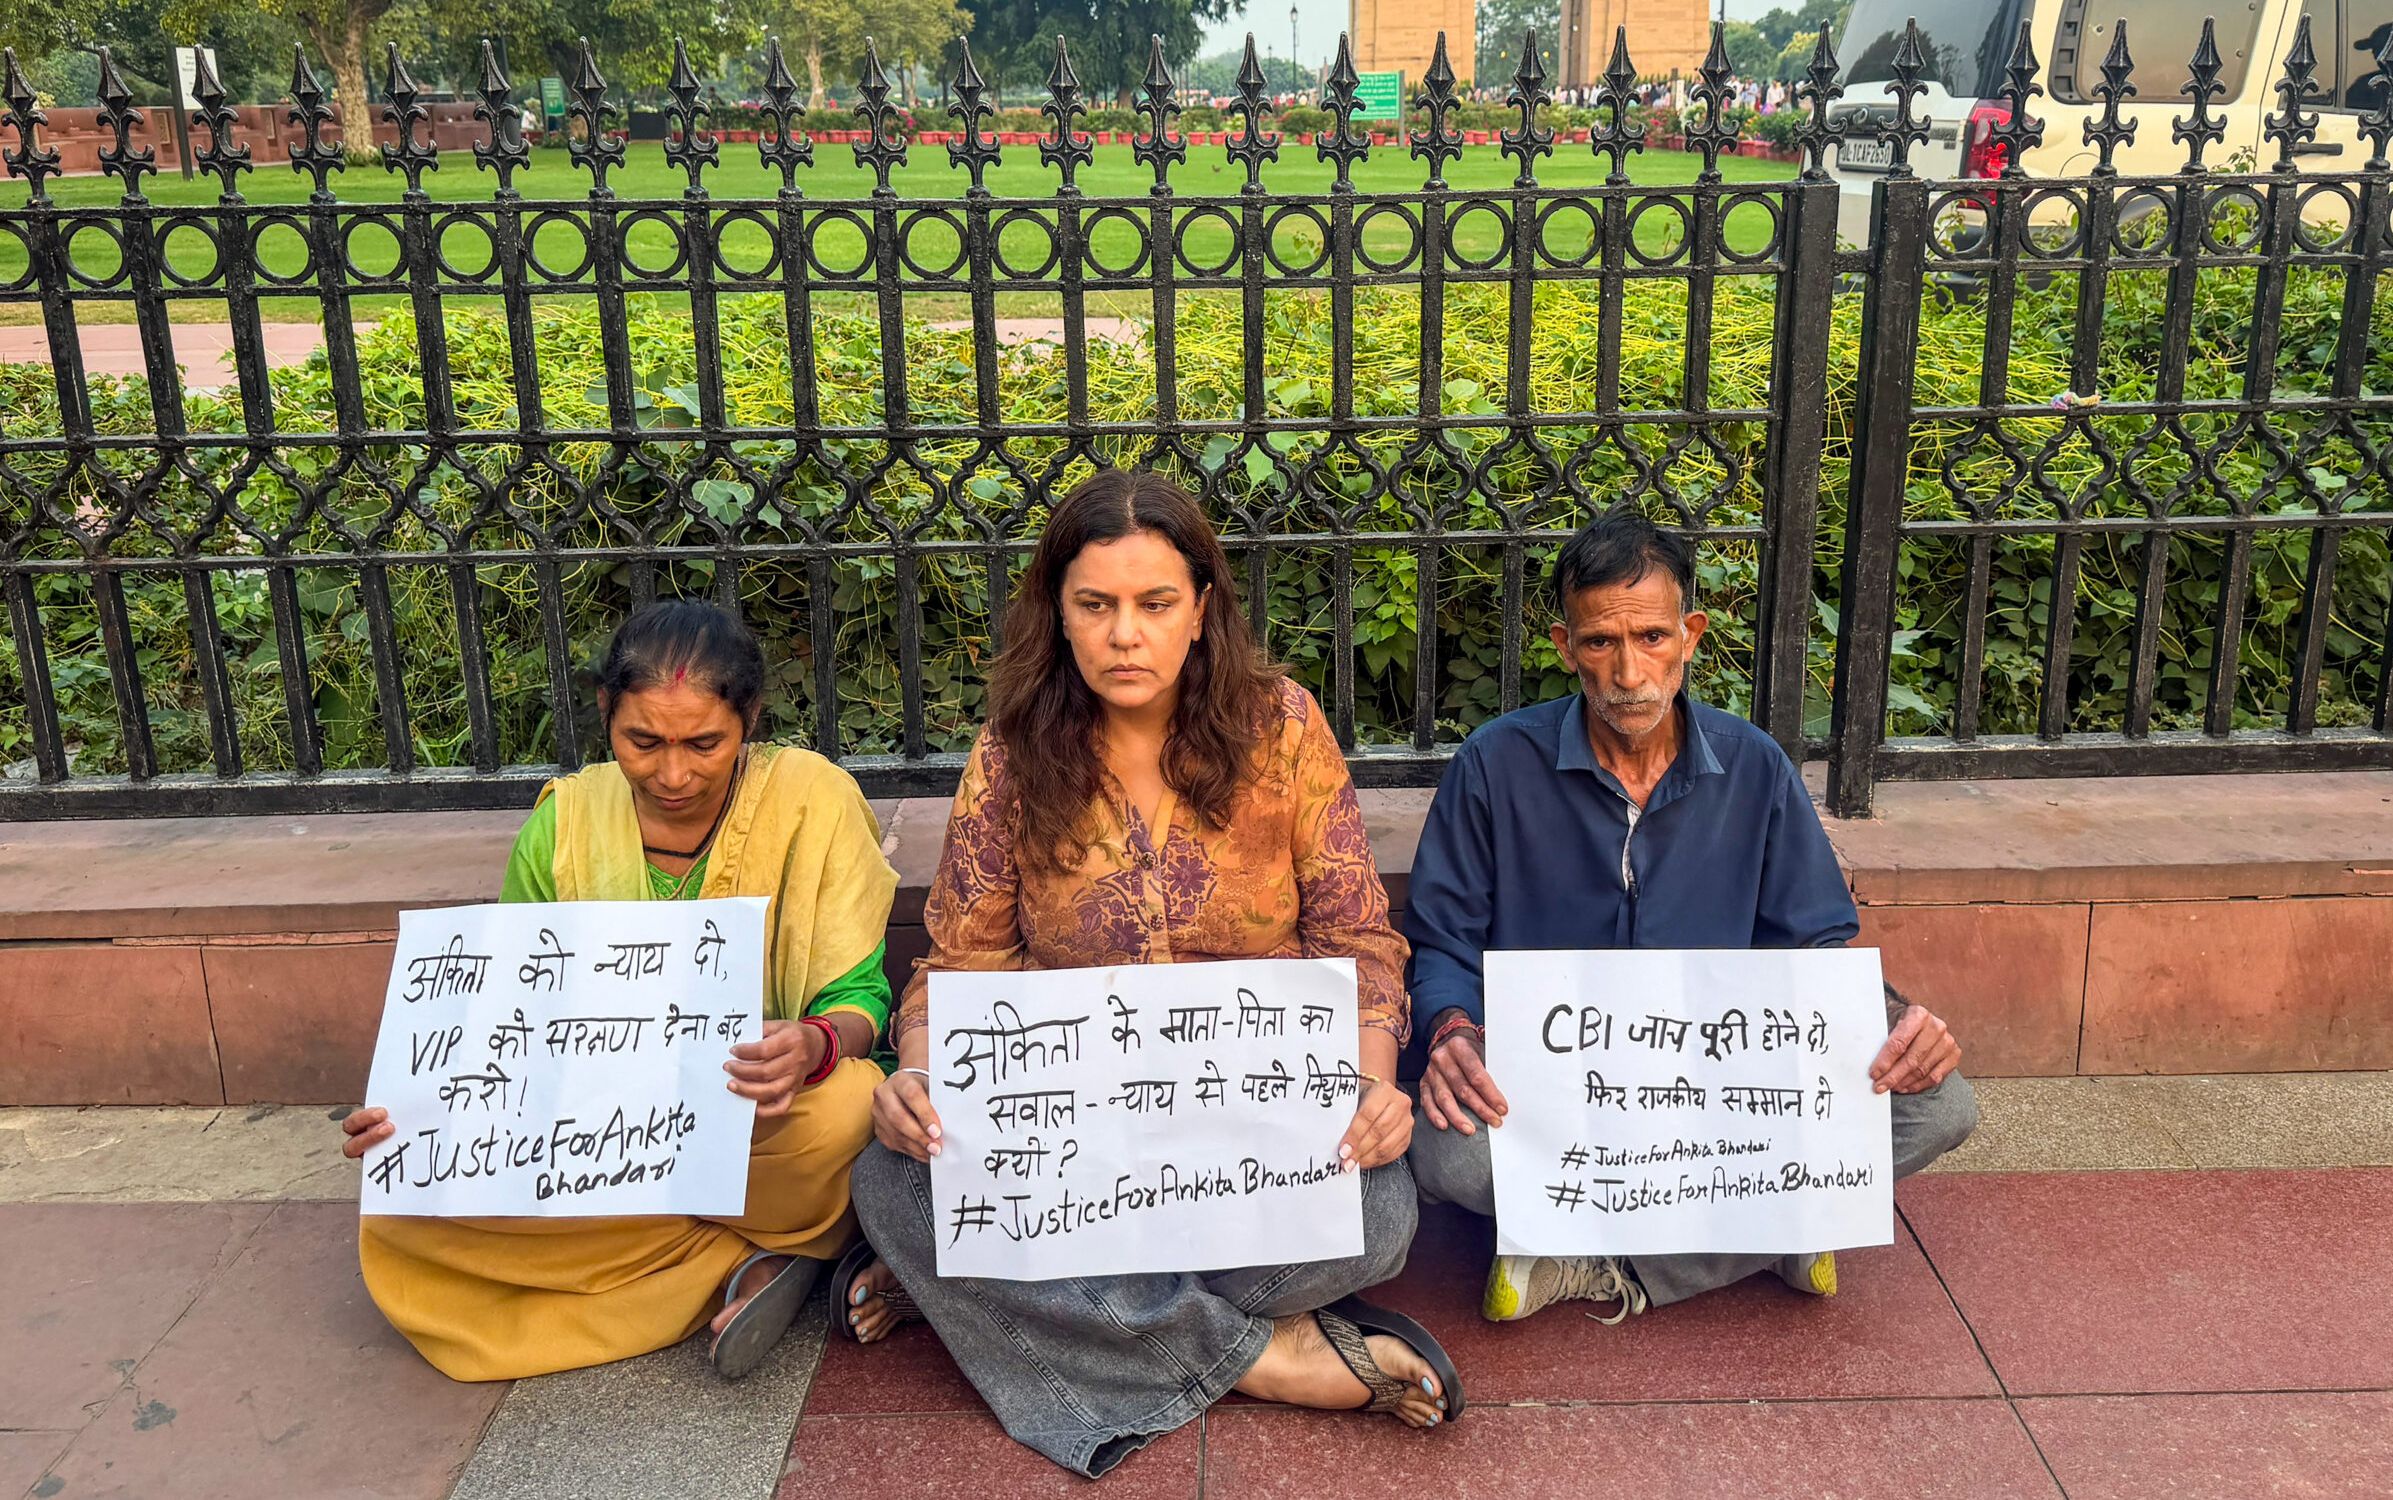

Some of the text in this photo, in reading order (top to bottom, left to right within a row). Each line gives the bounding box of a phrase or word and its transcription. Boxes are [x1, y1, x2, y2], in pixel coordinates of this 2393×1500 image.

[403, 919, 727, 1002] अंकिता को न्याय दो,
[411, 1026, 462, 1075] VIP
[489, 1009, 534, 1060] को
[663, 1004, 709, 1046] देना
[717, 1008, 747, 1042] बंद
[943, 988, 1332, 1091] अंकिता के माता-पिता का
[1542, 1004, 1611, 1053] CBI
[1700, 1009, 1747, 1060] पूरी
[1763, 1008, 1800, 1051] होने
[440, 1063, 528, 1116] करो!
[987, 1090, 1074, 1130] सवाल
[1109, 1081, 1177, 1115] न्याय
[1195, 1061, 1227, 1107] से
[1242, 1059, 1295, 1102] पहले
[1585, 1071, 1834, 1120] फिर राजकीय सम्मान दो
[536, 1144, 681, 1200] Bhandari
